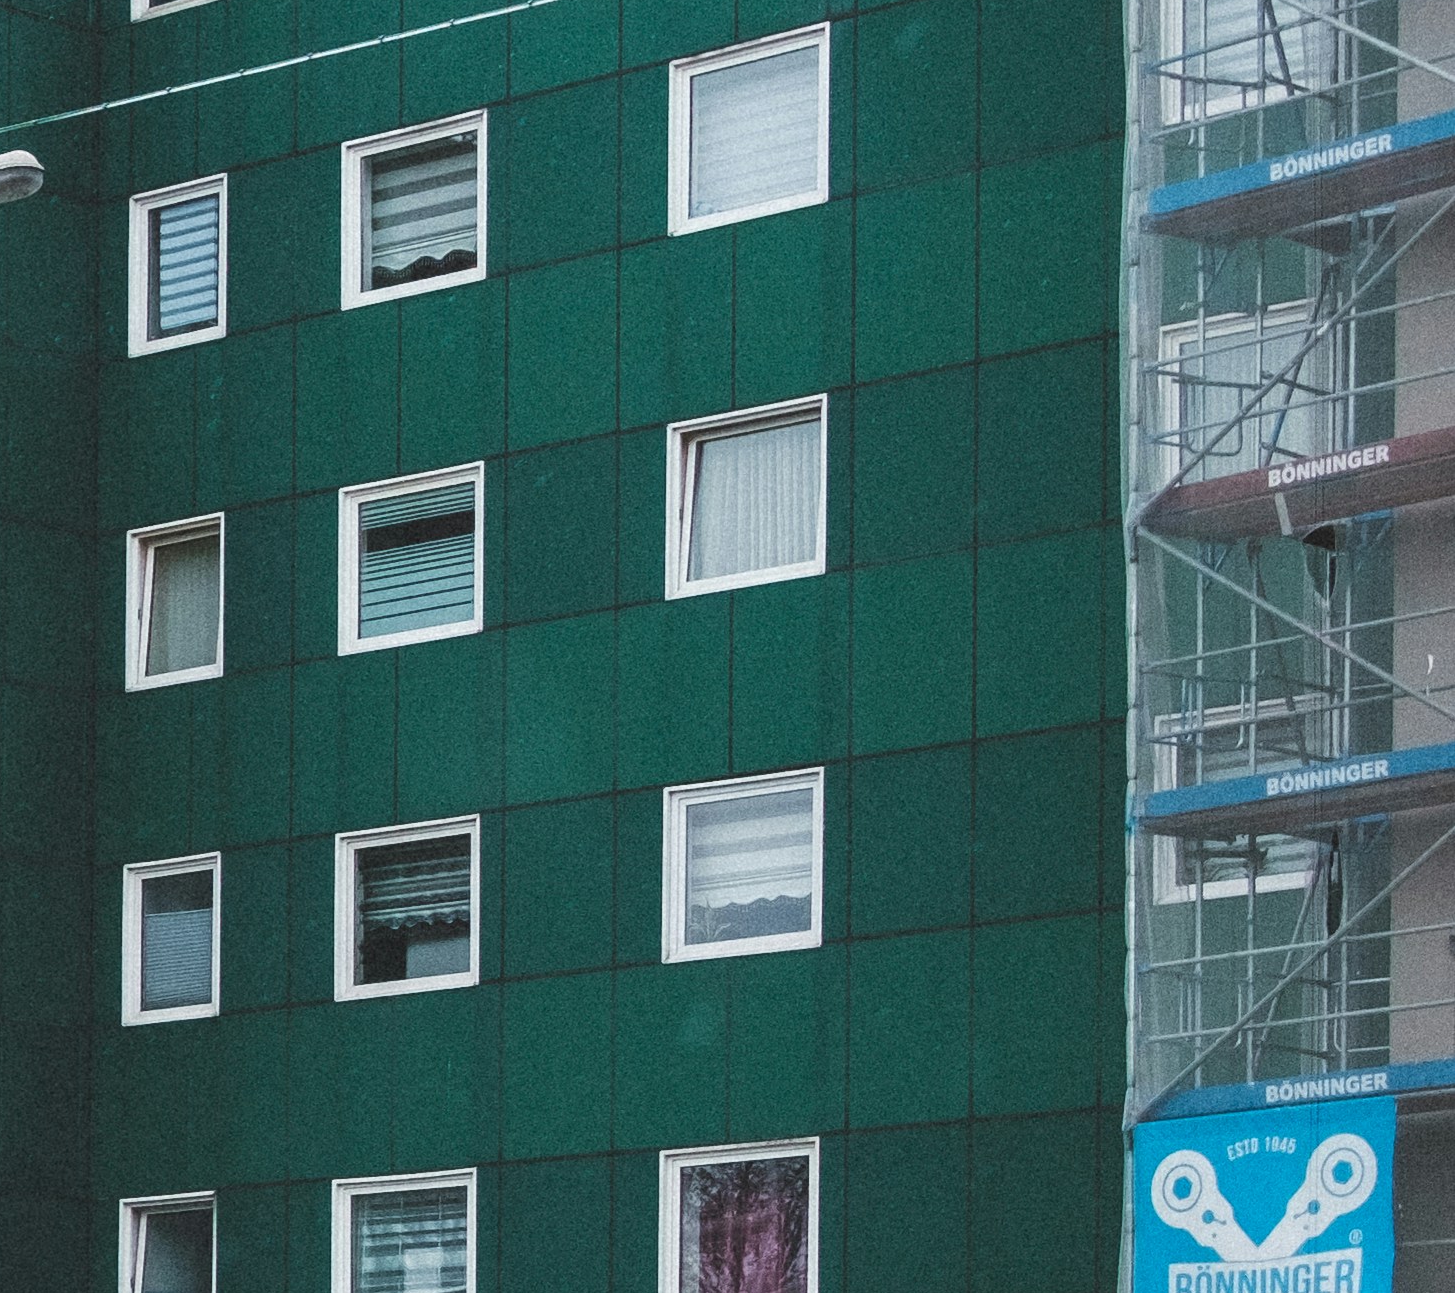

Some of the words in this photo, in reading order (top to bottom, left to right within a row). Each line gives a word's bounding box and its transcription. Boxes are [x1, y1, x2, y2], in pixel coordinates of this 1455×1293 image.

[1270, 134, 1392, 181] BÖNNINGER
[1268, 445, 1389, 488] BÖNNINGER
[1266, 760, 1388, 796] BÖNNINGER
[1265, 1073, 1387, 1102] BÖNNINGER
